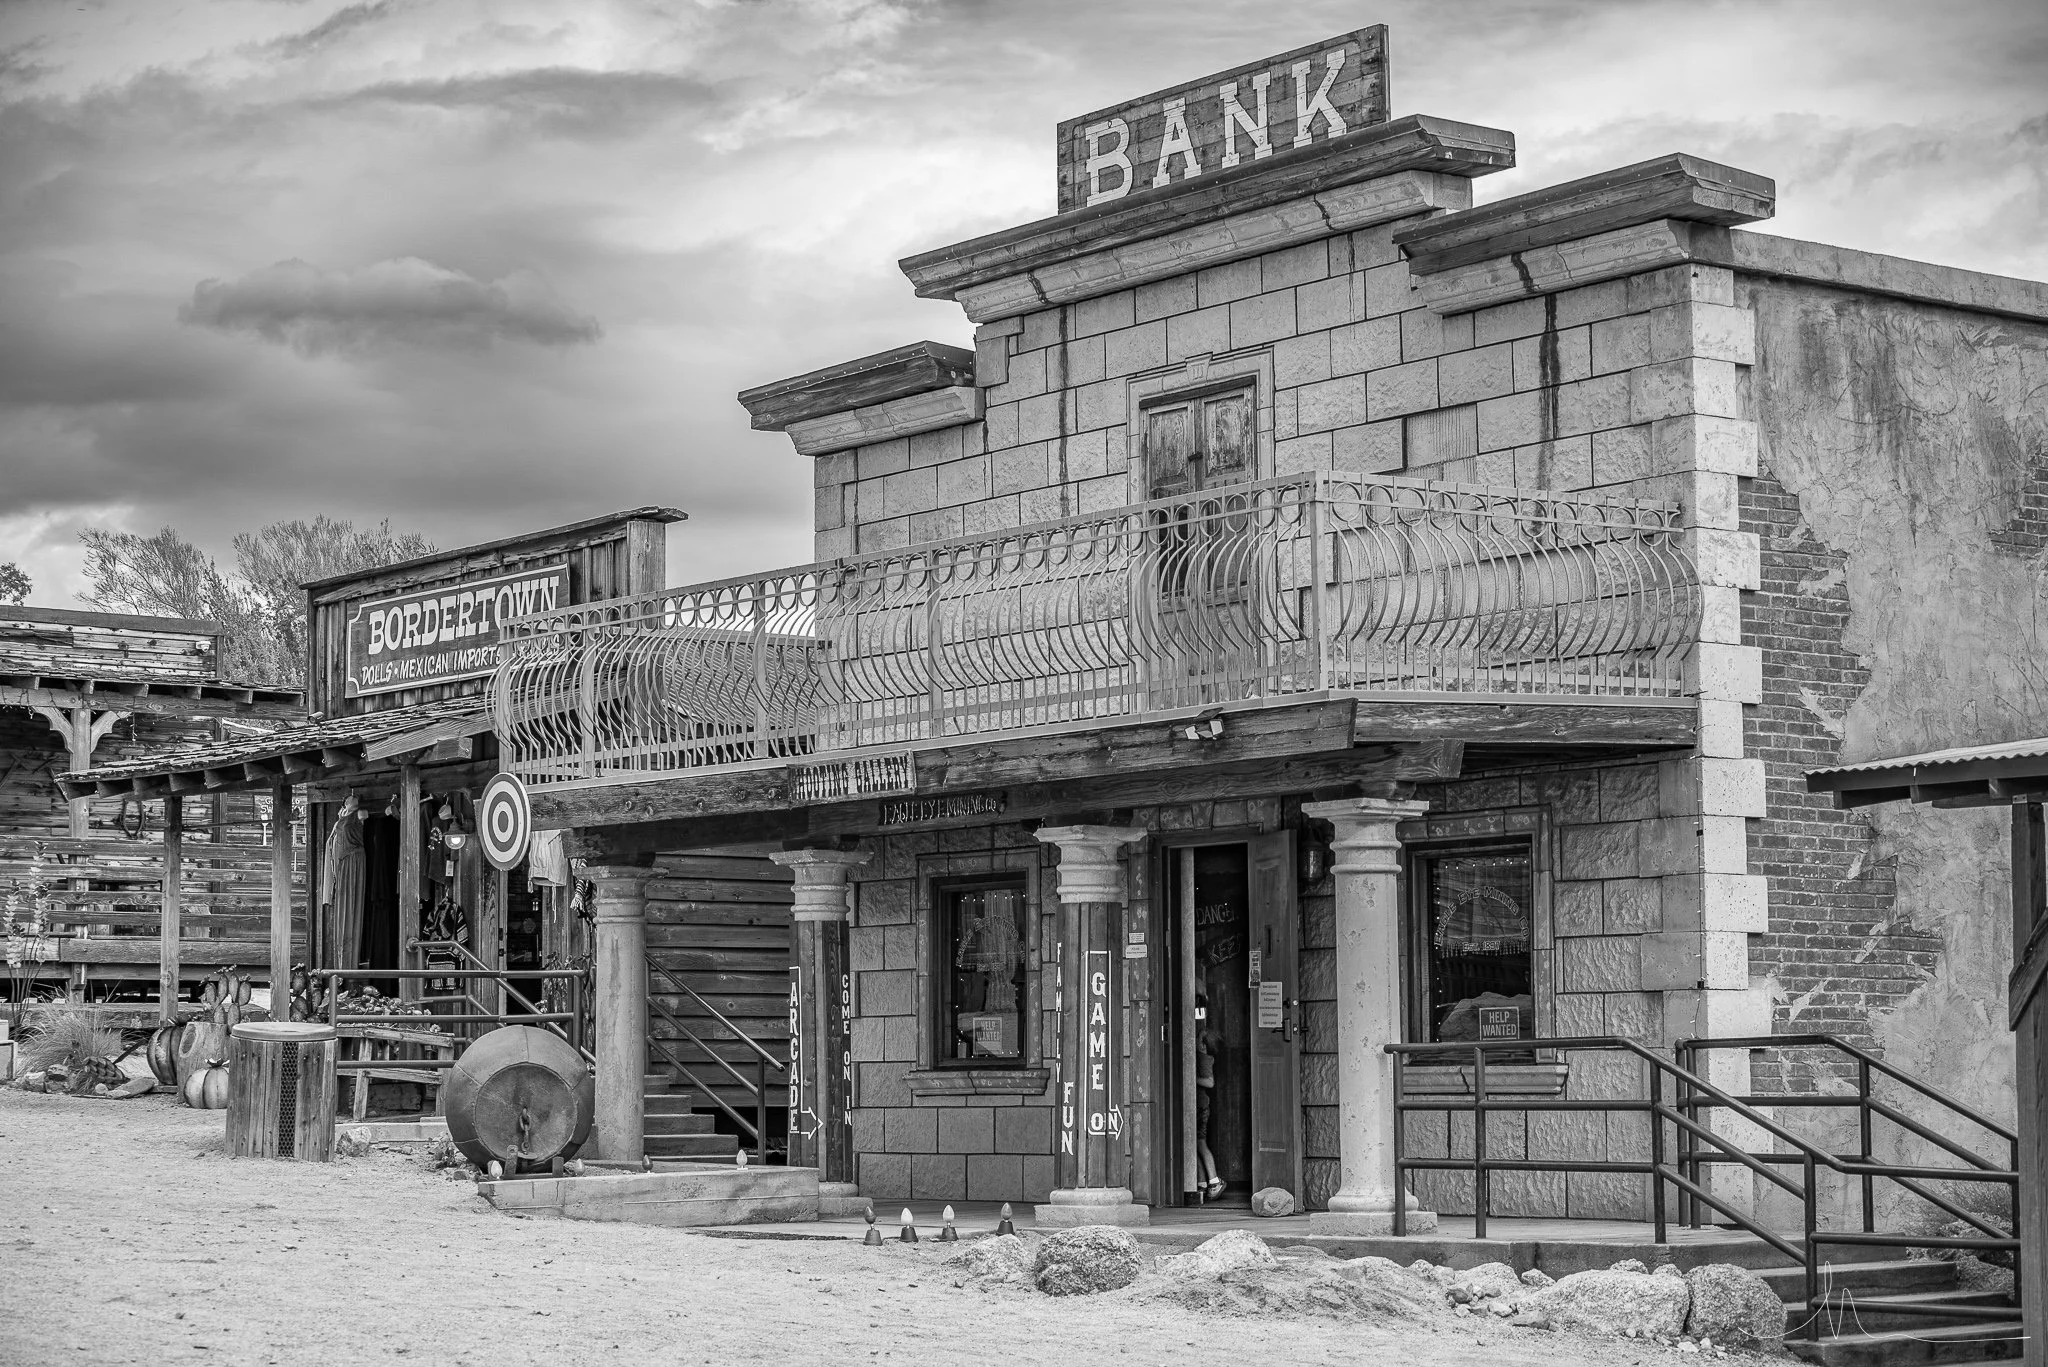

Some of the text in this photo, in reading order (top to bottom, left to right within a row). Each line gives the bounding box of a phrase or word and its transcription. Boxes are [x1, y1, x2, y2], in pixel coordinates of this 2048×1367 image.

[1085, 49, 1347, 207] BANK
[368, 576, 560, 655] BORDERTOWN
[361, 661, 393, 686] DOLLS
[399, 653, 449, 680] MEXICAN
[854, 757, 908, 793] GALLERY
[1433, 902, 1457, 947] EAGLE
[1457, 888, 1481, 905] EYE
[1483, 886, 1520, 916] MINING
[841, 974, 853, 1126] COME ON IN
[1089, 971, 1107, 1091] GAME
[1482, 1023, 1517, 1037] WANTED
[1488, 1011, 1510, 1024] HELP
[789, 981, 800, 1132] ARCADE
[1061, 1081, 1075, 1156] FUN
[1090, 1111, 1119, 1131] ON
